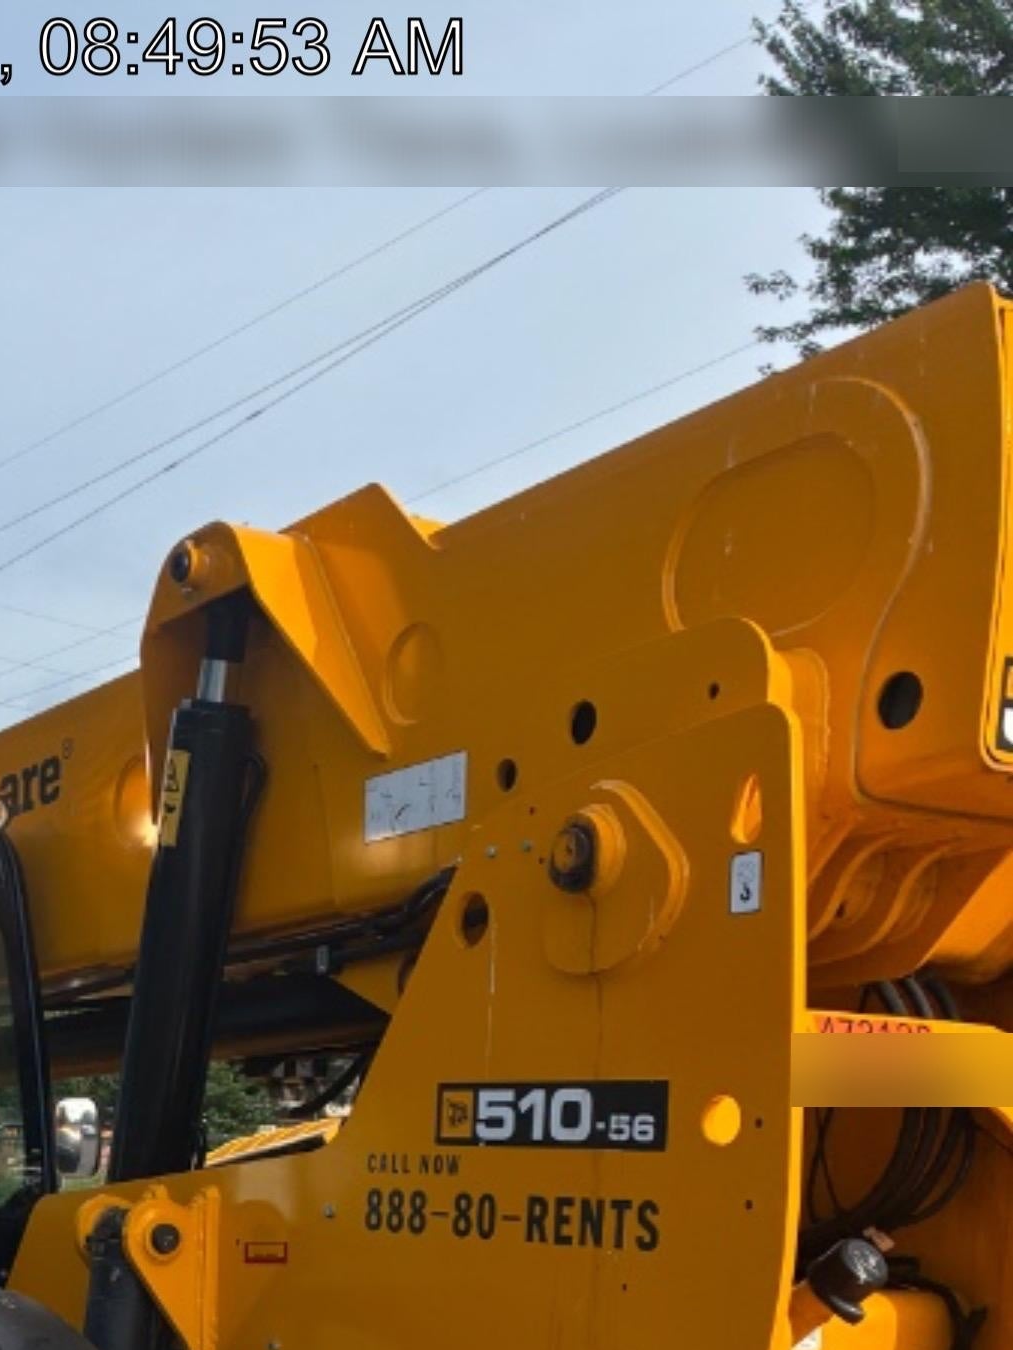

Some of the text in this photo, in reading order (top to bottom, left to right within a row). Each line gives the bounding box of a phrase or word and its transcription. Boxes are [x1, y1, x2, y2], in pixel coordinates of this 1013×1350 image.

[475, 1087, 656, 1142] 510-56
[367, 1153, 462, 1176] CALL NOW
[364, 1187, 661, 1252] 888-80-RENTS
